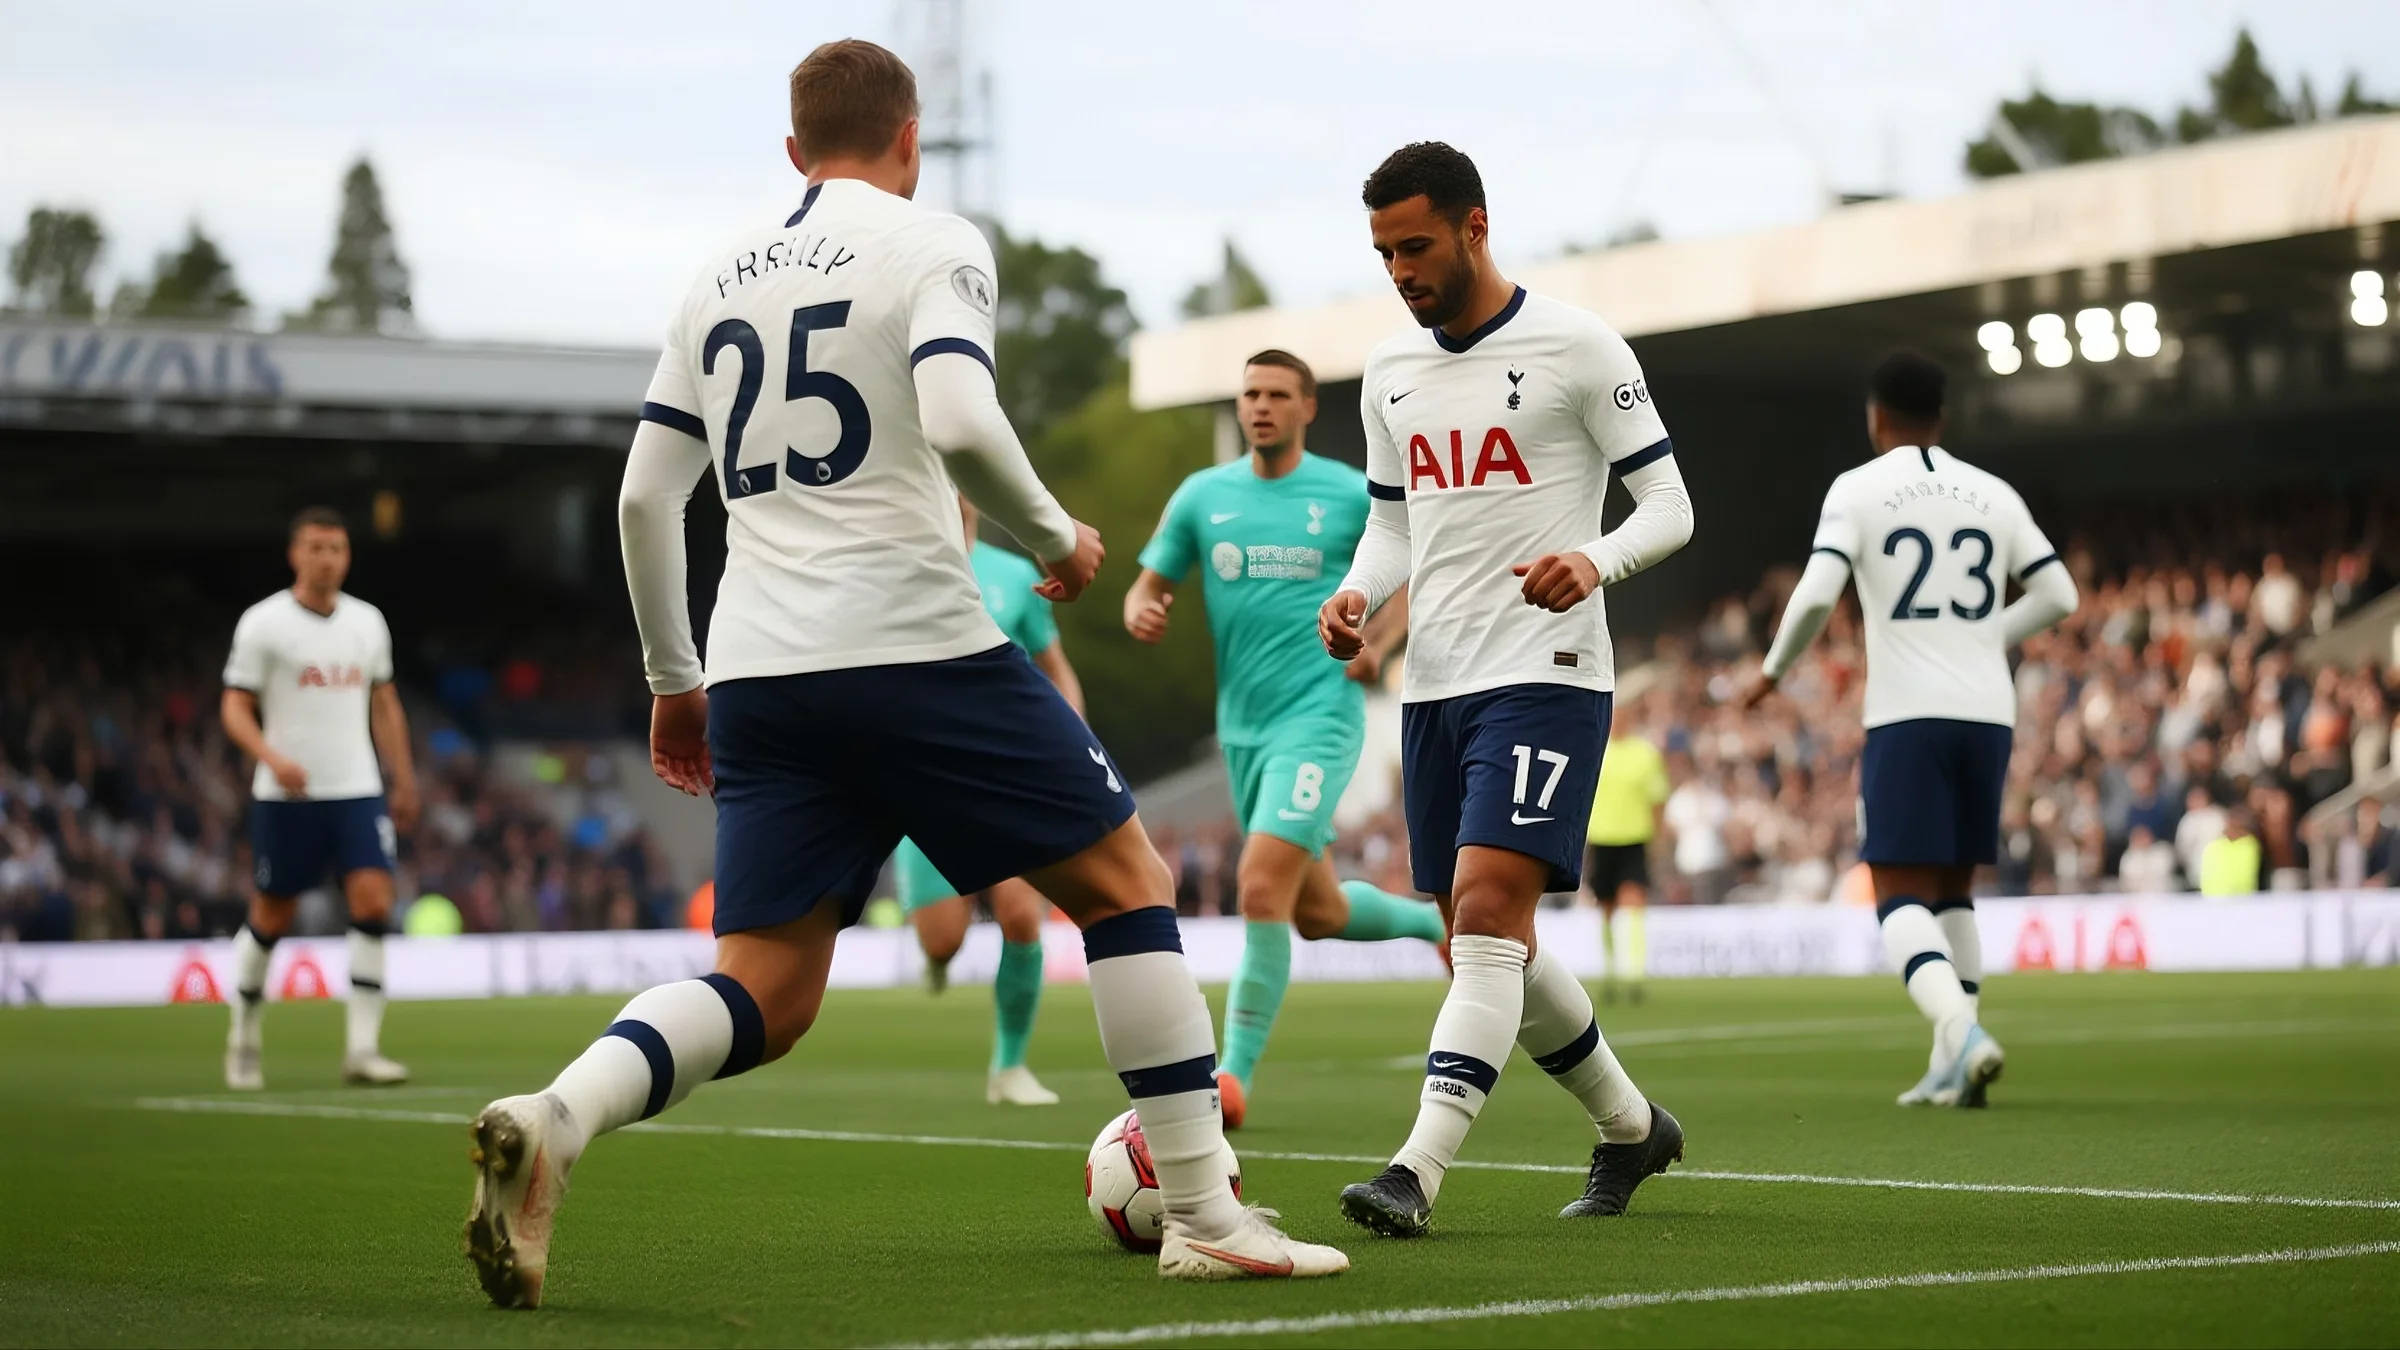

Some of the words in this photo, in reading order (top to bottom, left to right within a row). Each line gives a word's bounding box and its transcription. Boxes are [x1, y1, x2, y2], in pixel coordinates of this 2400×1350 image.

[702, 299, 872, 500] 25
[1409, 426, 1533, 491] AIA
[1883, 527, 1996, 620] 23
[1291, 761, 1325, 812] 8
[1511, 744, 1570, 811] 17
[2014, 906, 2150, 972] AIA
